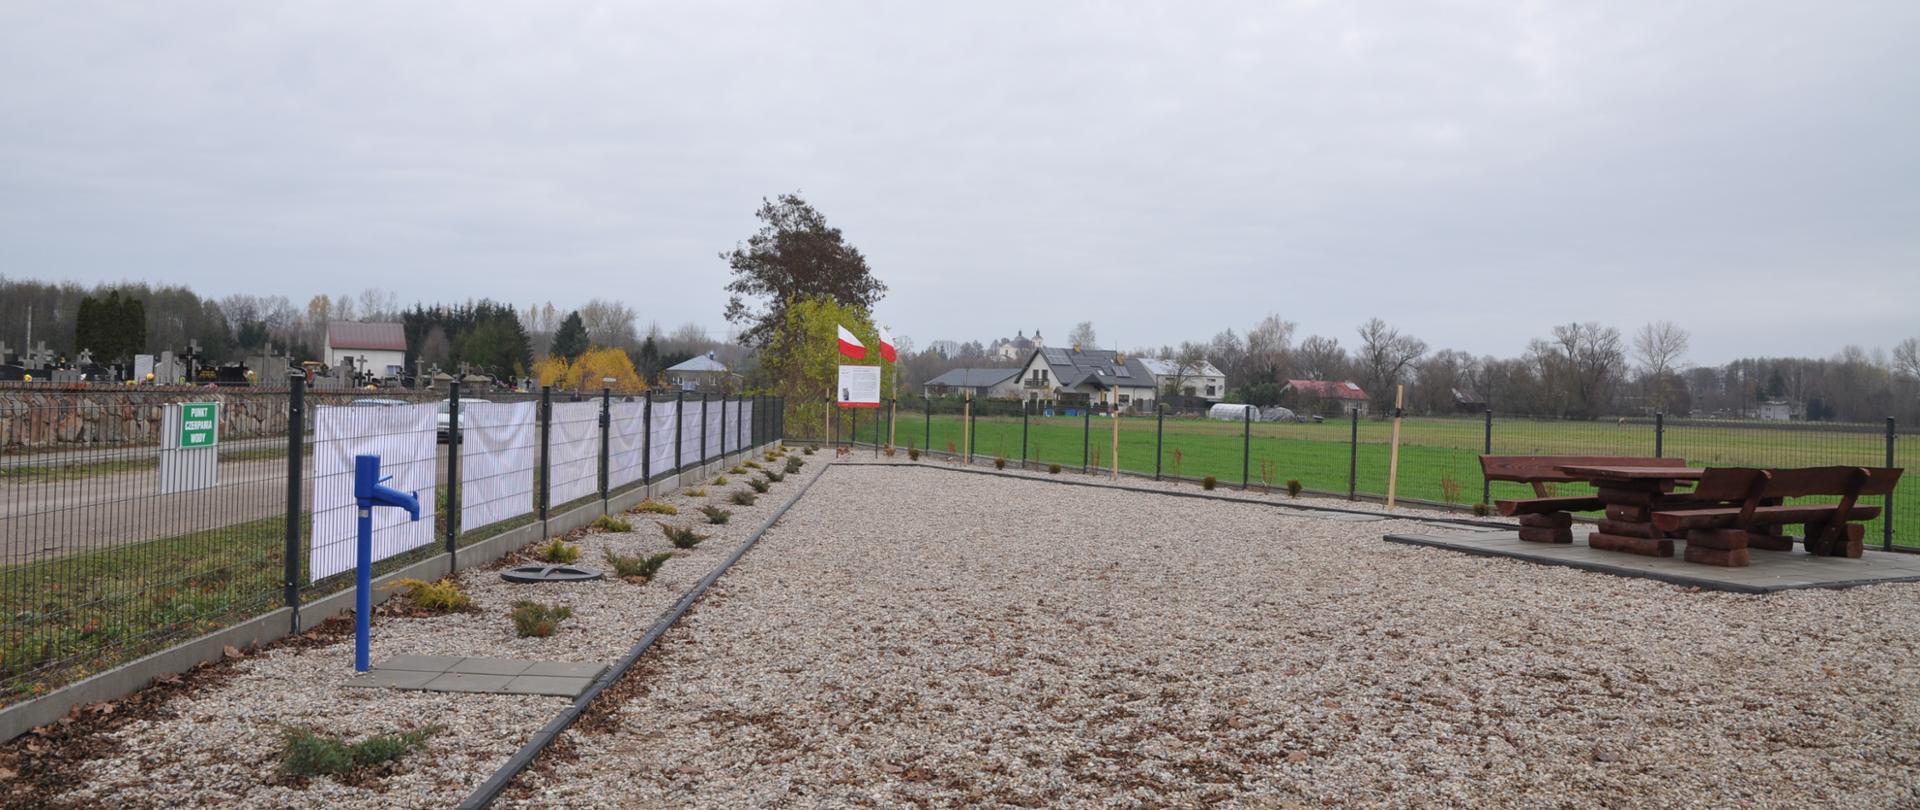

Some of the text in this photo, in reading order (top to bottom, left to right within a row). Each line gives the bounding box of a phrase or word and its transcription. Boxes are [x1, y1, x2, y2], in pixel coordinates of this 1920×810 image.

[190, 407, 208, 418] PUNKT
[184, 420, 213, 431] CZERPANIA
[190, 433, 206, 443] WODY
